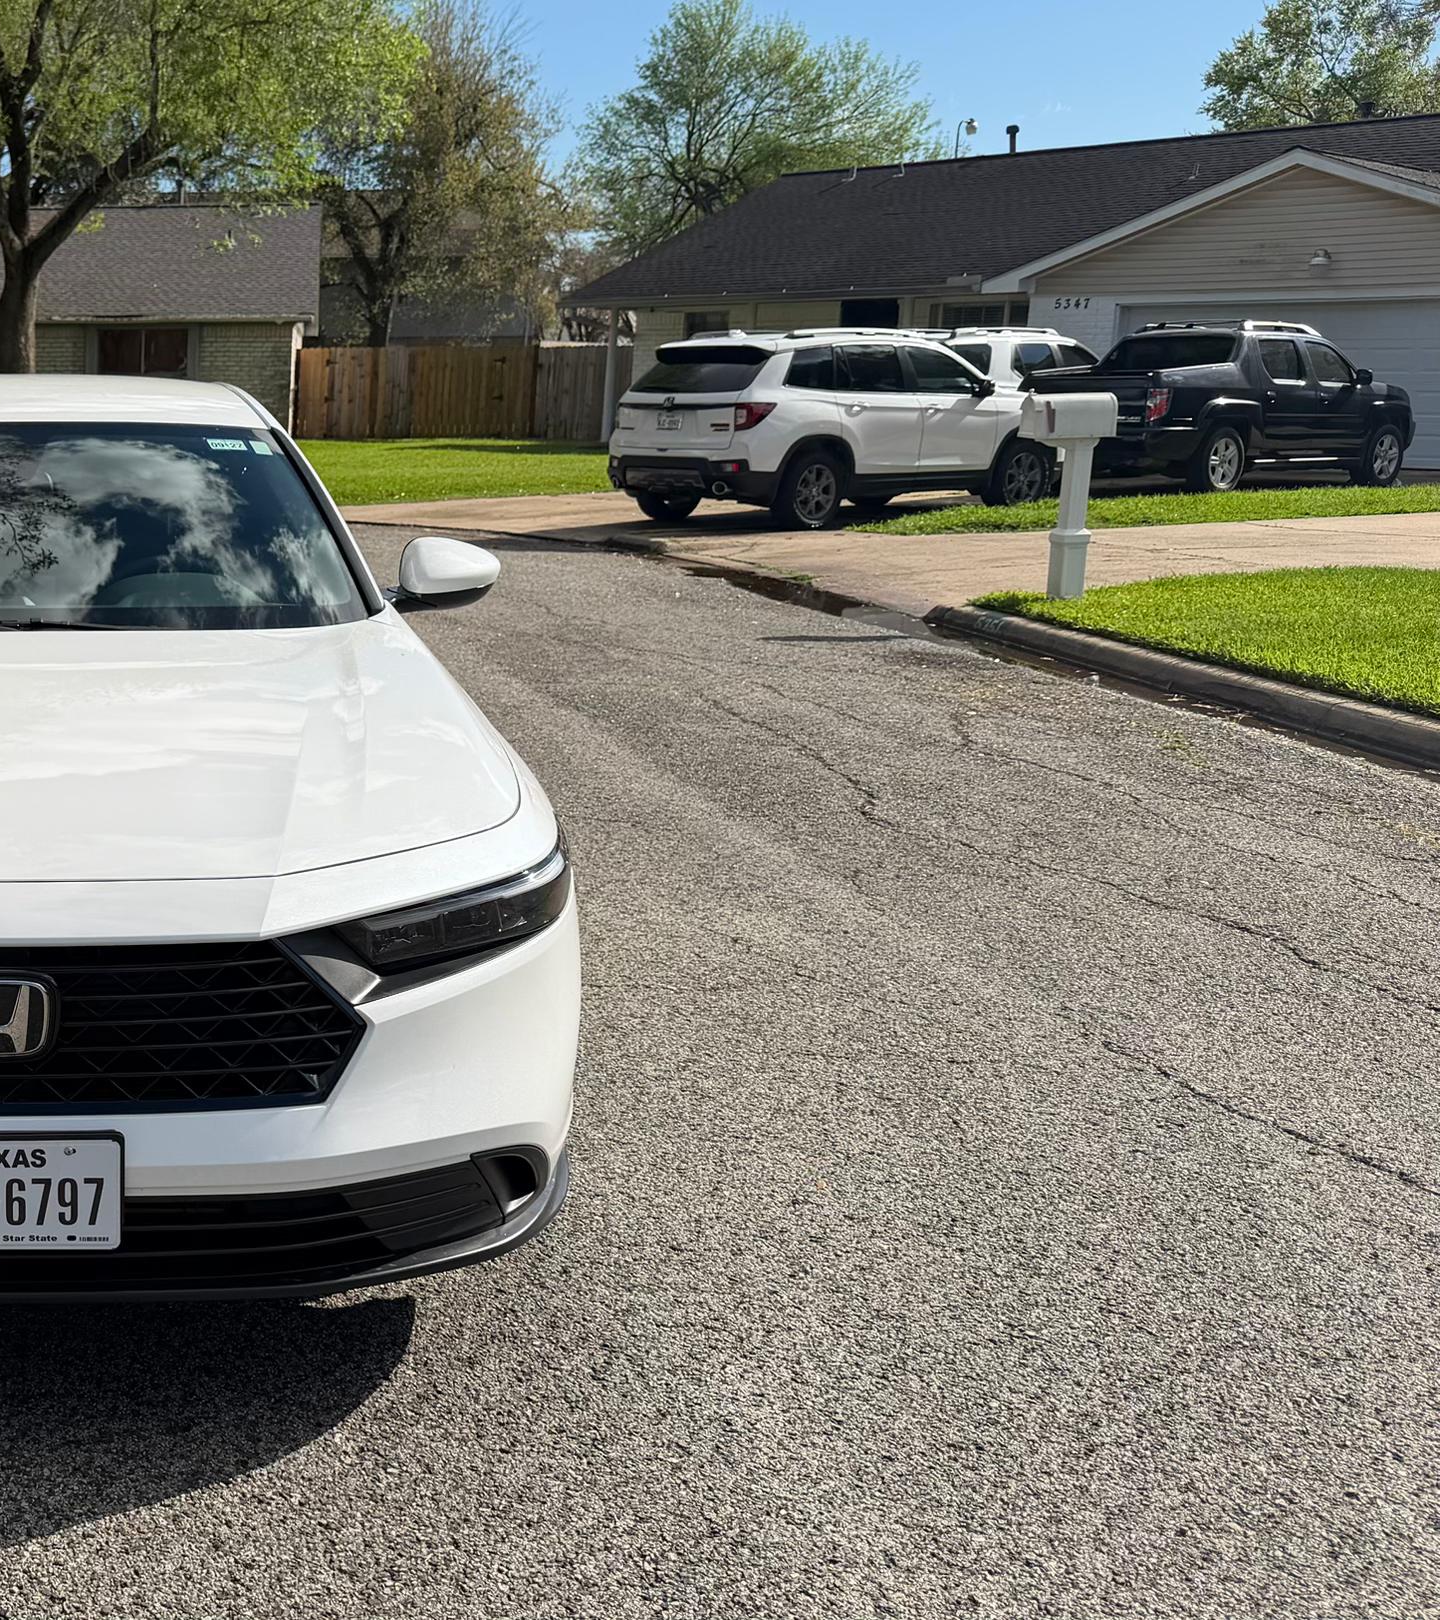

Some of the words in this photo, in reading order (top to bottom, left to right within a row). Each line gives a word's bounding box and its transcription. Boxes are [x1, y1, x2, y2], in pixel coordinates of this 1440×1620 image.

[1054, 298, 1090, 309] 5347
[5, 1177, 105, 1227] 6797
[2, 1234, 26, 1242] Star
[28, 1234, 58, 1242] State
